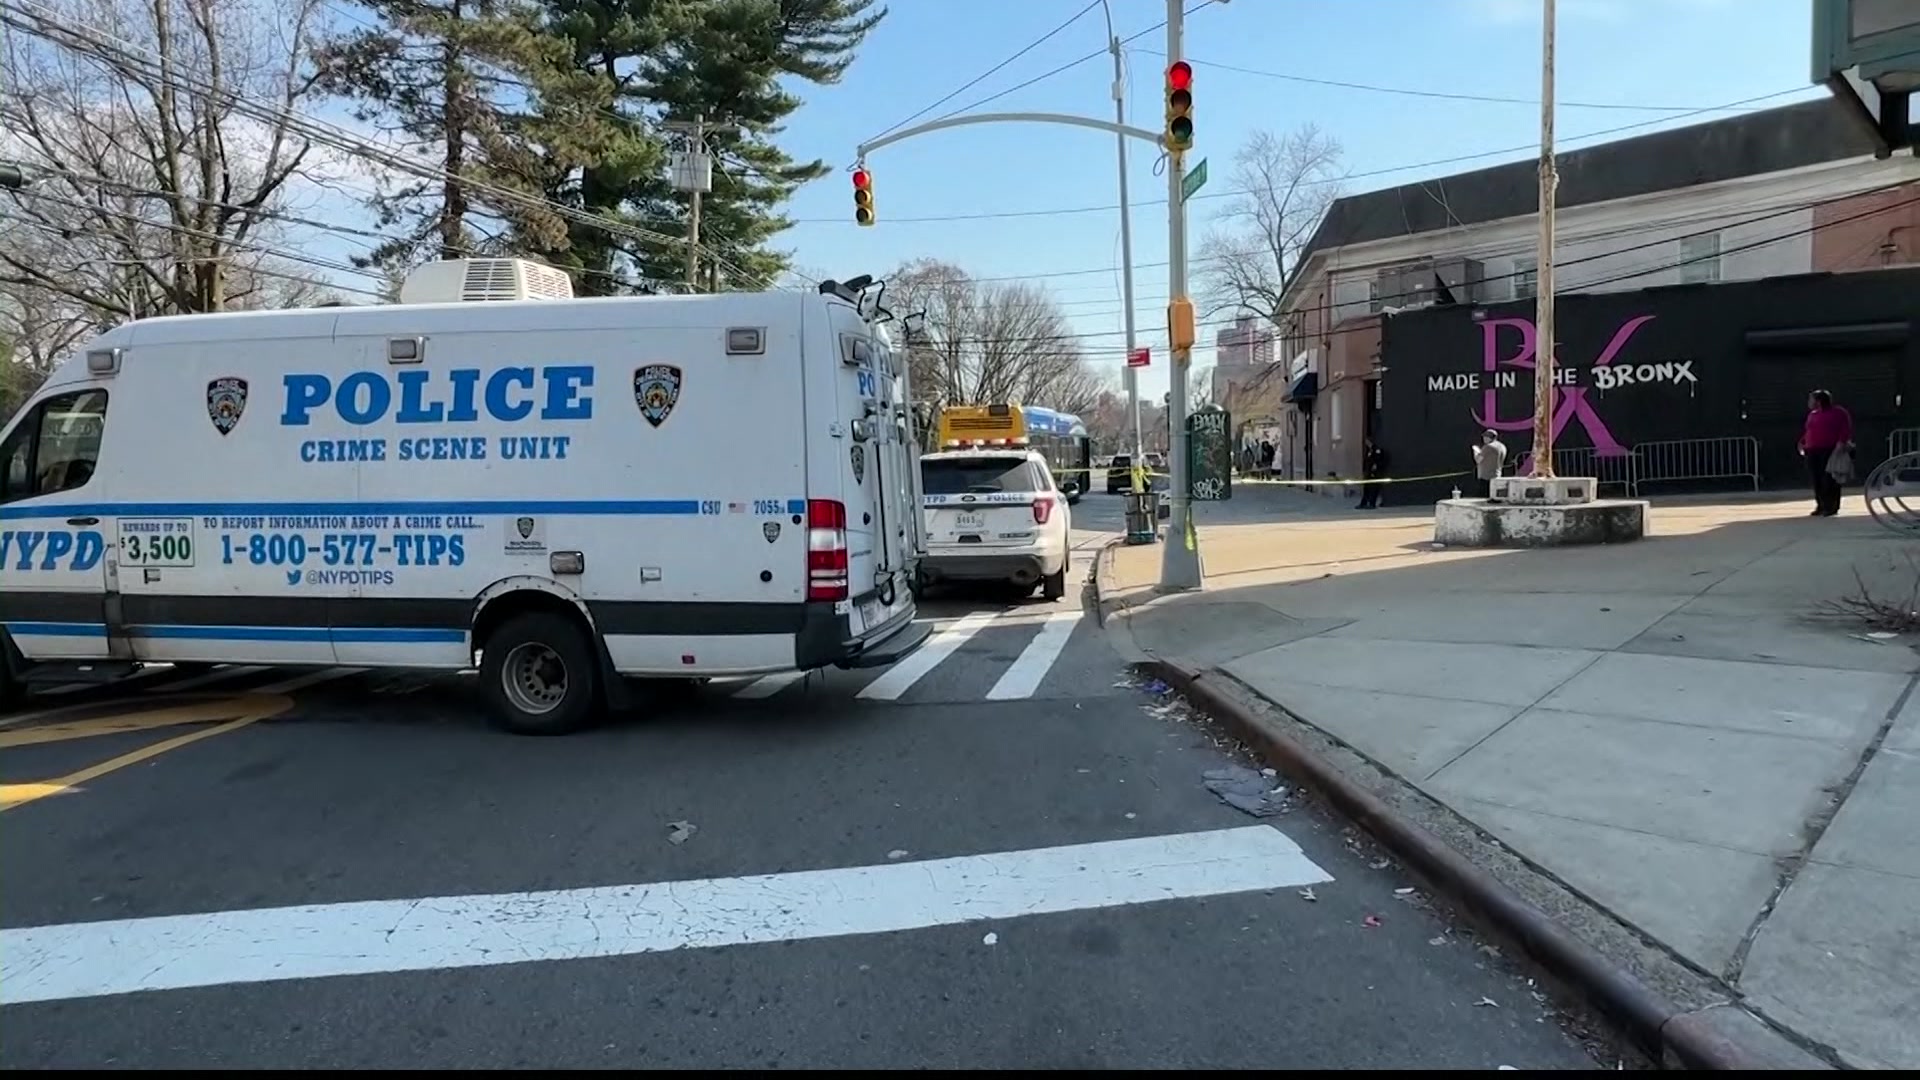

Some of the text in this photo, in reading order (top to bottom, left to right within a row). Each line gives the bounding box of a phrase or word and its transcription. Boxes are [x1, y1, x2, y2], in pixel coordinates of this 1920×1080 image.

[1428, 360, 1698, 391] MADE IN HE BRONX
[281, 366, 594, 424] POLICE
[300, 436, 570, 463] CRIME SCENE UNIT
[701, 500, 721, 515] CSU
[122, 522, 188, 532] REWARDS UP TO
[203, 517, 218, 529] TO
[222, 517, 264, 529] REPORT
[269, 517, 347, 529] INFORMATION
[351, 516, 389, 529] ABOUT
[393, 517, 404, 529] A
[405, 516, 441, 529] CRIME
[120, 535, 191, 563] $3,500
[221, 533, 465, 566] 1-800-577-TIPS
[306, 570, 394, 585] @NYPDTIPS
